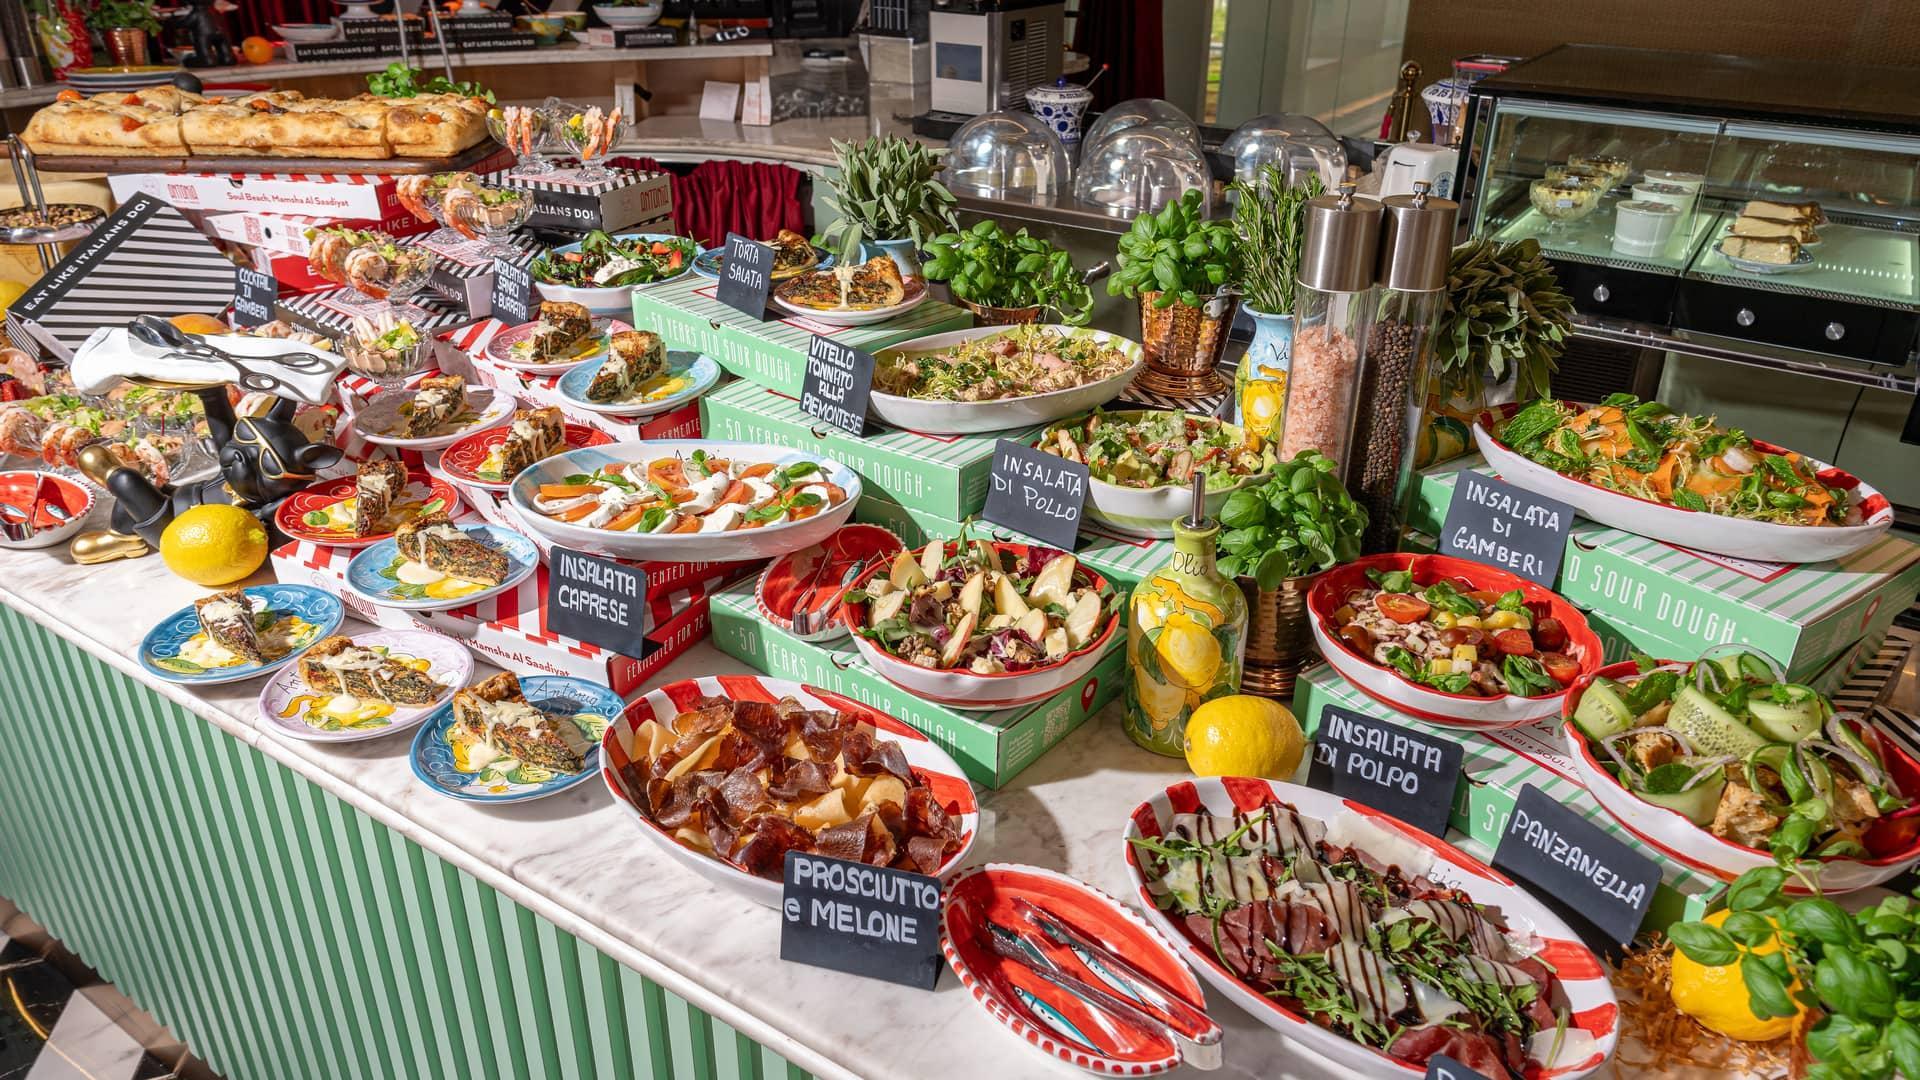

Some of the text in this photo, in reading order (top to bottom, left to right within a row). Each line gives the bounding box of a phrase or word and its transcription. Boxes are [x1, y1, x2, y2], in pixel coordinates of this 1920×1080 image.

[227, 192, 244, 200] Soul
[245, 193, 271, 203] Beach,
[272, 195, 305, 204] Mamsha
[315, 197, 349, 208] Saadiyat
[533, 204, 594, 220] ALIANS DO!
[24, 199, 151, 312] EAT LIKE ITALIANS DO!
[733, 238, 760, 265] TORTA
[239, 268, 272, 291] COCKTAIL
[728, 262, 762, 290] SALATA
[235, 295, 268, 320] GAMBERI
[651, 311, 792, 385] 50 YEARS OLD SOUR DOUGH
[812, 336, 855, 371] VITELLO
[808, 356, 853, 391] TONNATO
[818, 379, 846, 404] ALLA
[657, 417, 701, 440] FERMENTE
[802, 391, 863, 434] PIEMONTESE
[725, 417, 742, 441] 50
[873, 461, 924, 499] DOUGH
[1003, 454, 1082, 497] INSALATA
[992, 471, 1012, 496] DI
[1023, 485, 1078, 521] POLLO
[1466, 480, 1560, 532] INSALATA
[1492, 517, 1512, 538] DI
[1452, 526, 1544, 576] GAMBERI
[559, 553, 637, 598] INSALATA
[558, 585, 629, 627] CAPRESE
[1590, 564, 1647, 612] SOUR
[1656, 591, 1737, 645] DOUGH
[412, 618, 434, 632] Soul
[468, 637, 511, 660] Mamsha
[512, 651, 524, 664] Al
[526, 657, 571, 678] Saadiyat
[626, 614, 705, 682] FERMENTED FOR 72
[739, 627, 756, 656] 50
[764, 639, 808, 682] YEARS
[851, 682, 892, 716] SOUR
[901, 708, 957, 757] DOUGH
[1327, 714, 1442, 773] INSALATA
[1314, 742, 1419, 795] DI POLPO
[1510, 809, 1647, 910] PANZANELLA
[793, 857, 940, 910] PROSCIUTTO
[784, 897, 918, 945] e MELONE
